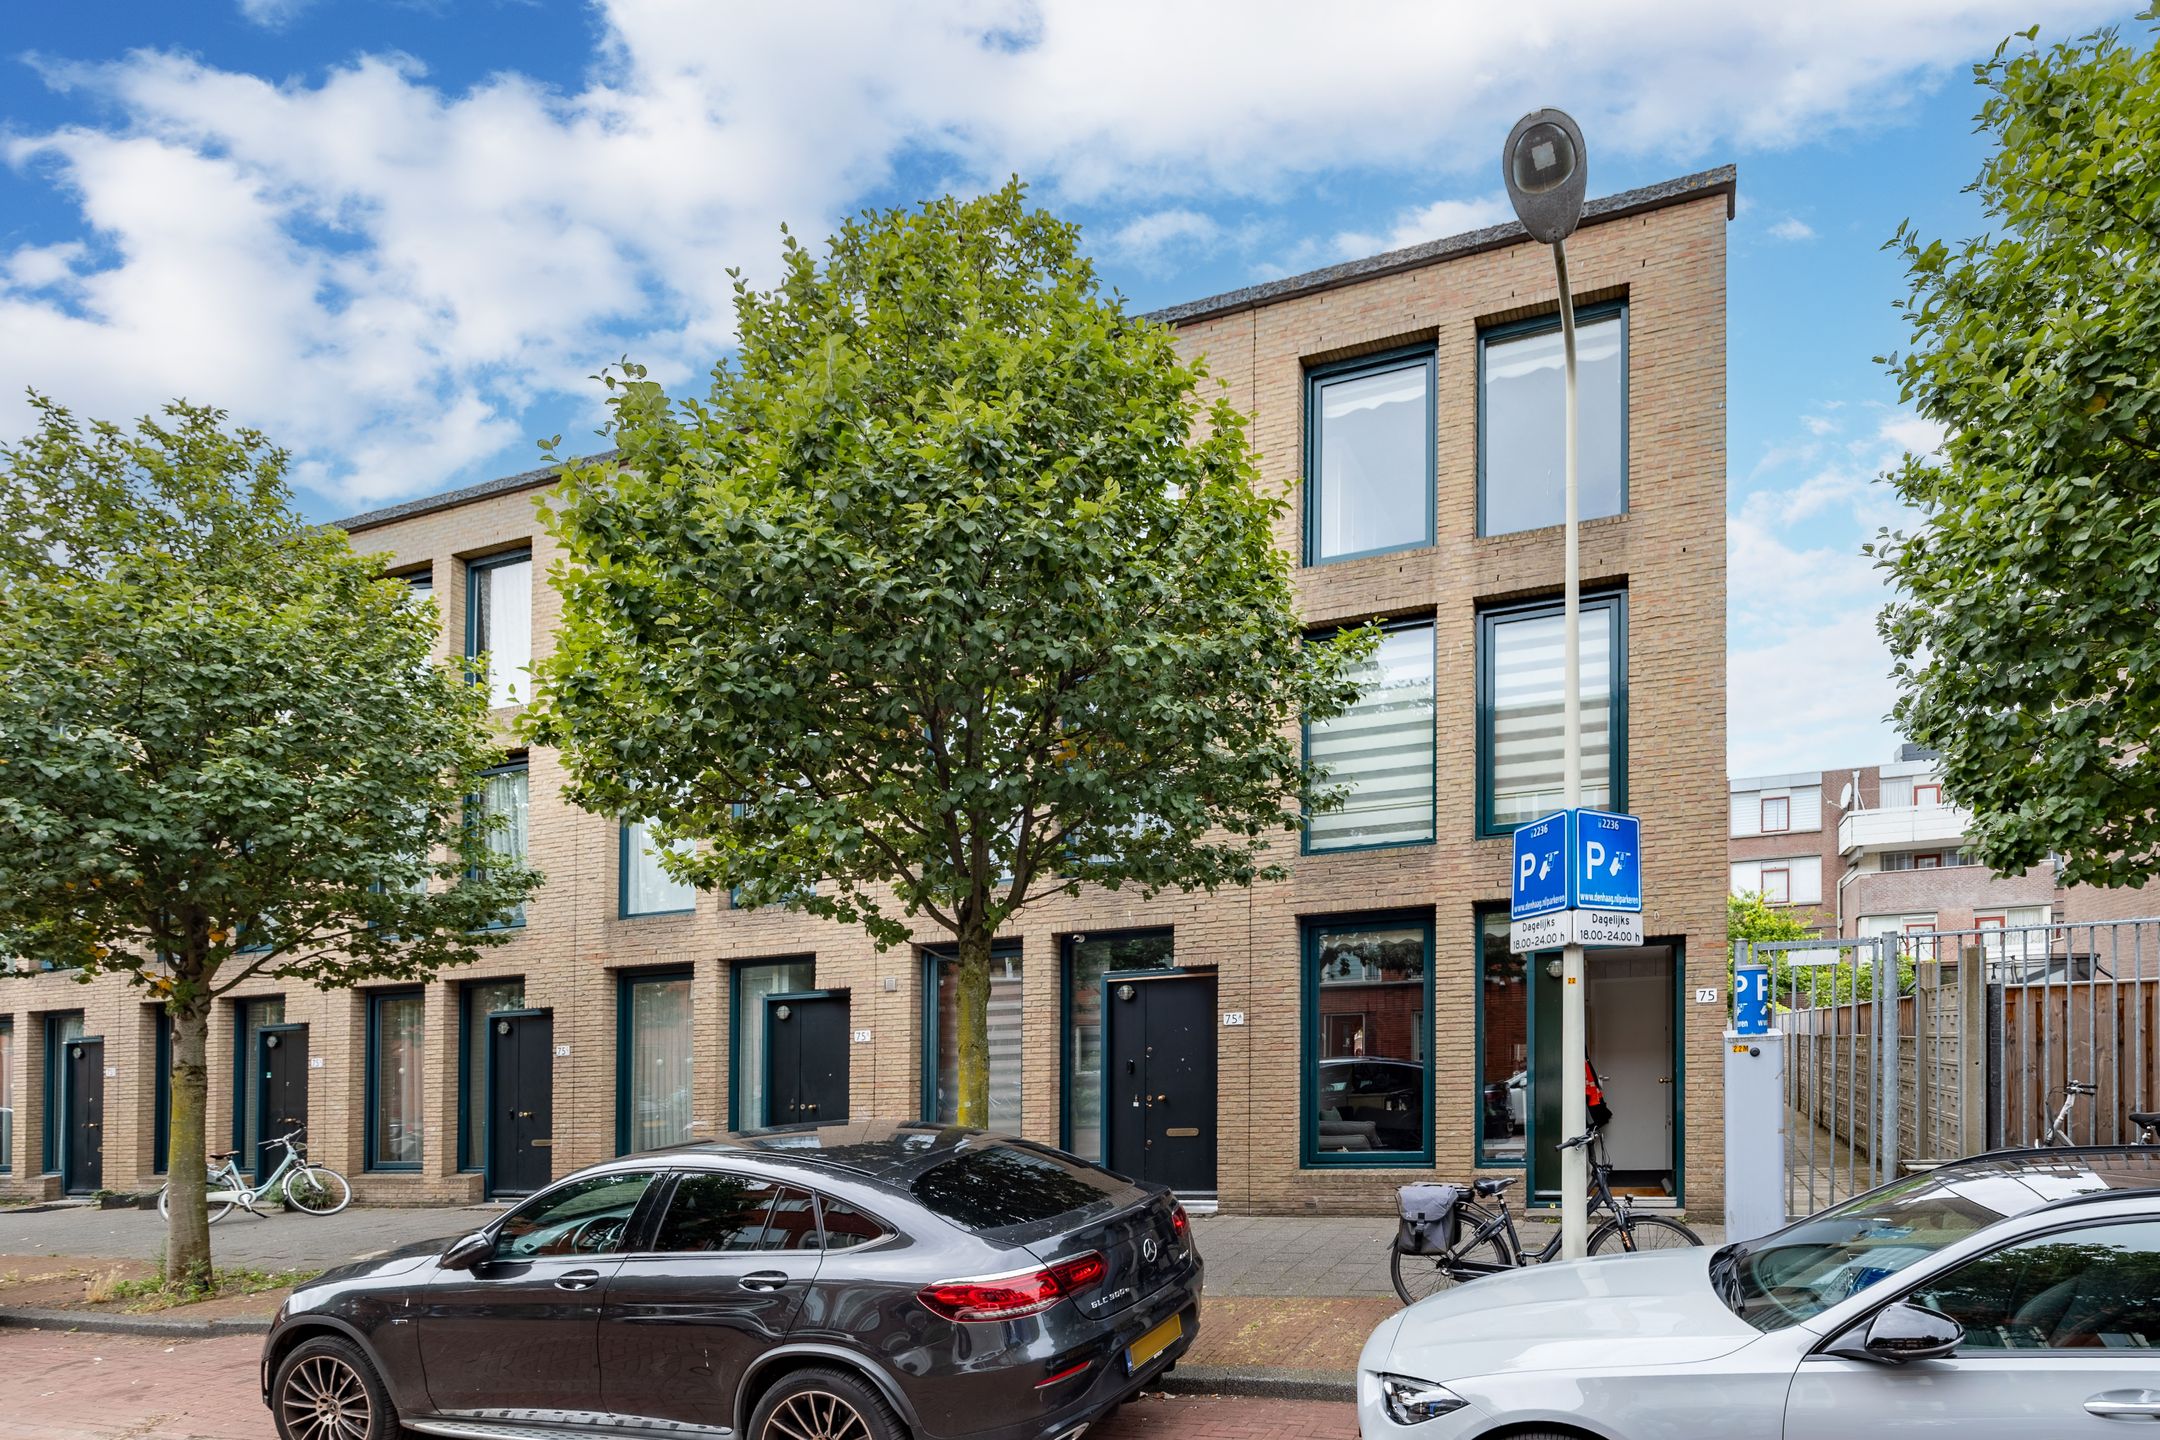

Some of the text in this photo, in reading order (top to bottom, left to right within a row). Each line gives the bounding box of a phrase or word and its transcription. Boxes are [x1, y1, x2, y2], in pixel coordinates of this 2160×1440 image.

[1533, 823, 1549, 838] 2236
[1602, 818, 1620, 831] 2236
[1586, 840, 1606, 880] P
[1520, 852, 1537, 892] P
[1522, 918, 1556, 933] Dagelijks
[1592, 913, 1630, 928] Dagelijks
[1513, 931, 1565, 951] 18.00-24.00 h
[1580, 929, 1640, 943] 18.00-24.00 h
[1699, 990, 1715, 1001] 75
[1733, 1045, 1749, 1053] 22M
[1091, 1296, 1109, 1309] GLC
